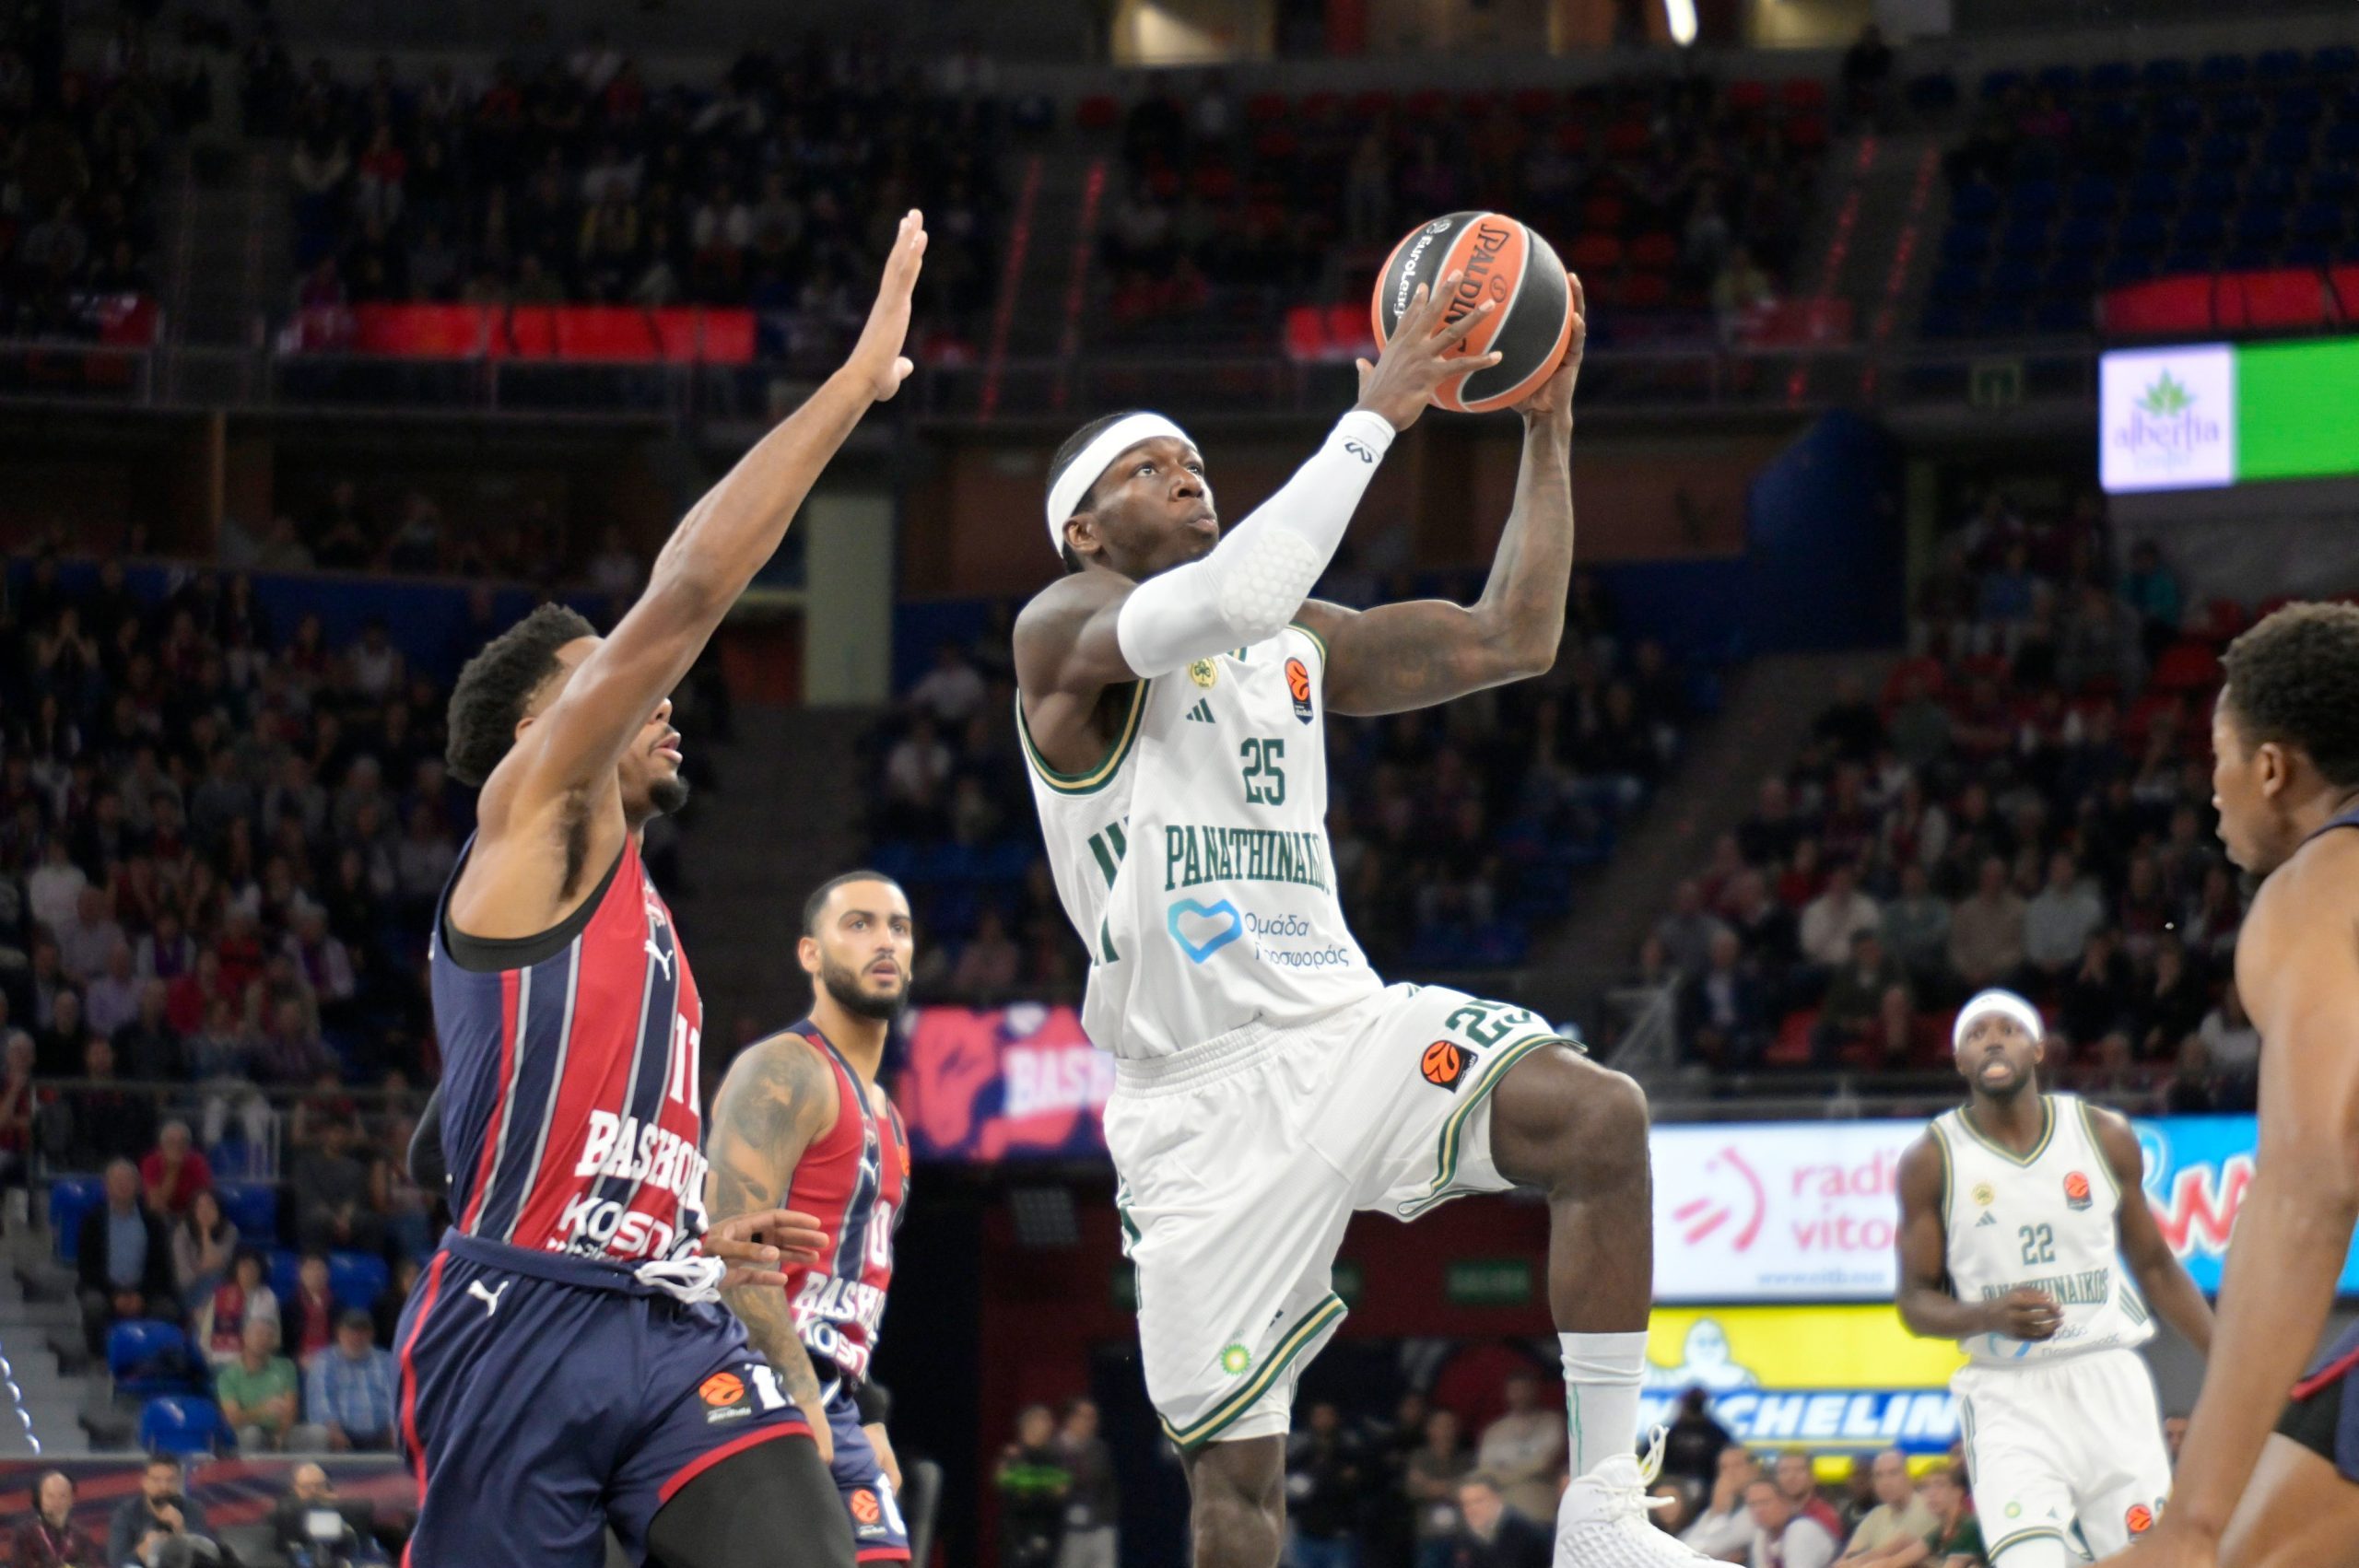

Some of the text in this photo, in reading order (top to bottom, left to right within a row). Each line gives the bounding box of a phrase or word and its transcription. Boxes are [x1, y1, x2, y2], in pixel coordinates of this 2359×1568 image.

[1437, 223, 1509, 353] SPALDIN
[1240, 737, 1285, 806] 25
[1245, 912, 1309, 940] Ομάδα
[1254, 942, 1349, 970] οσφοράς
[670, 1013, 701, 1117] 11
[1792, 1147, 1898, 1198] radi
[869, 1200, 891, 1267] 0
[1791, 1200, 1895, 1251] vito
[2018, 1223, 2055, 1266] 22
